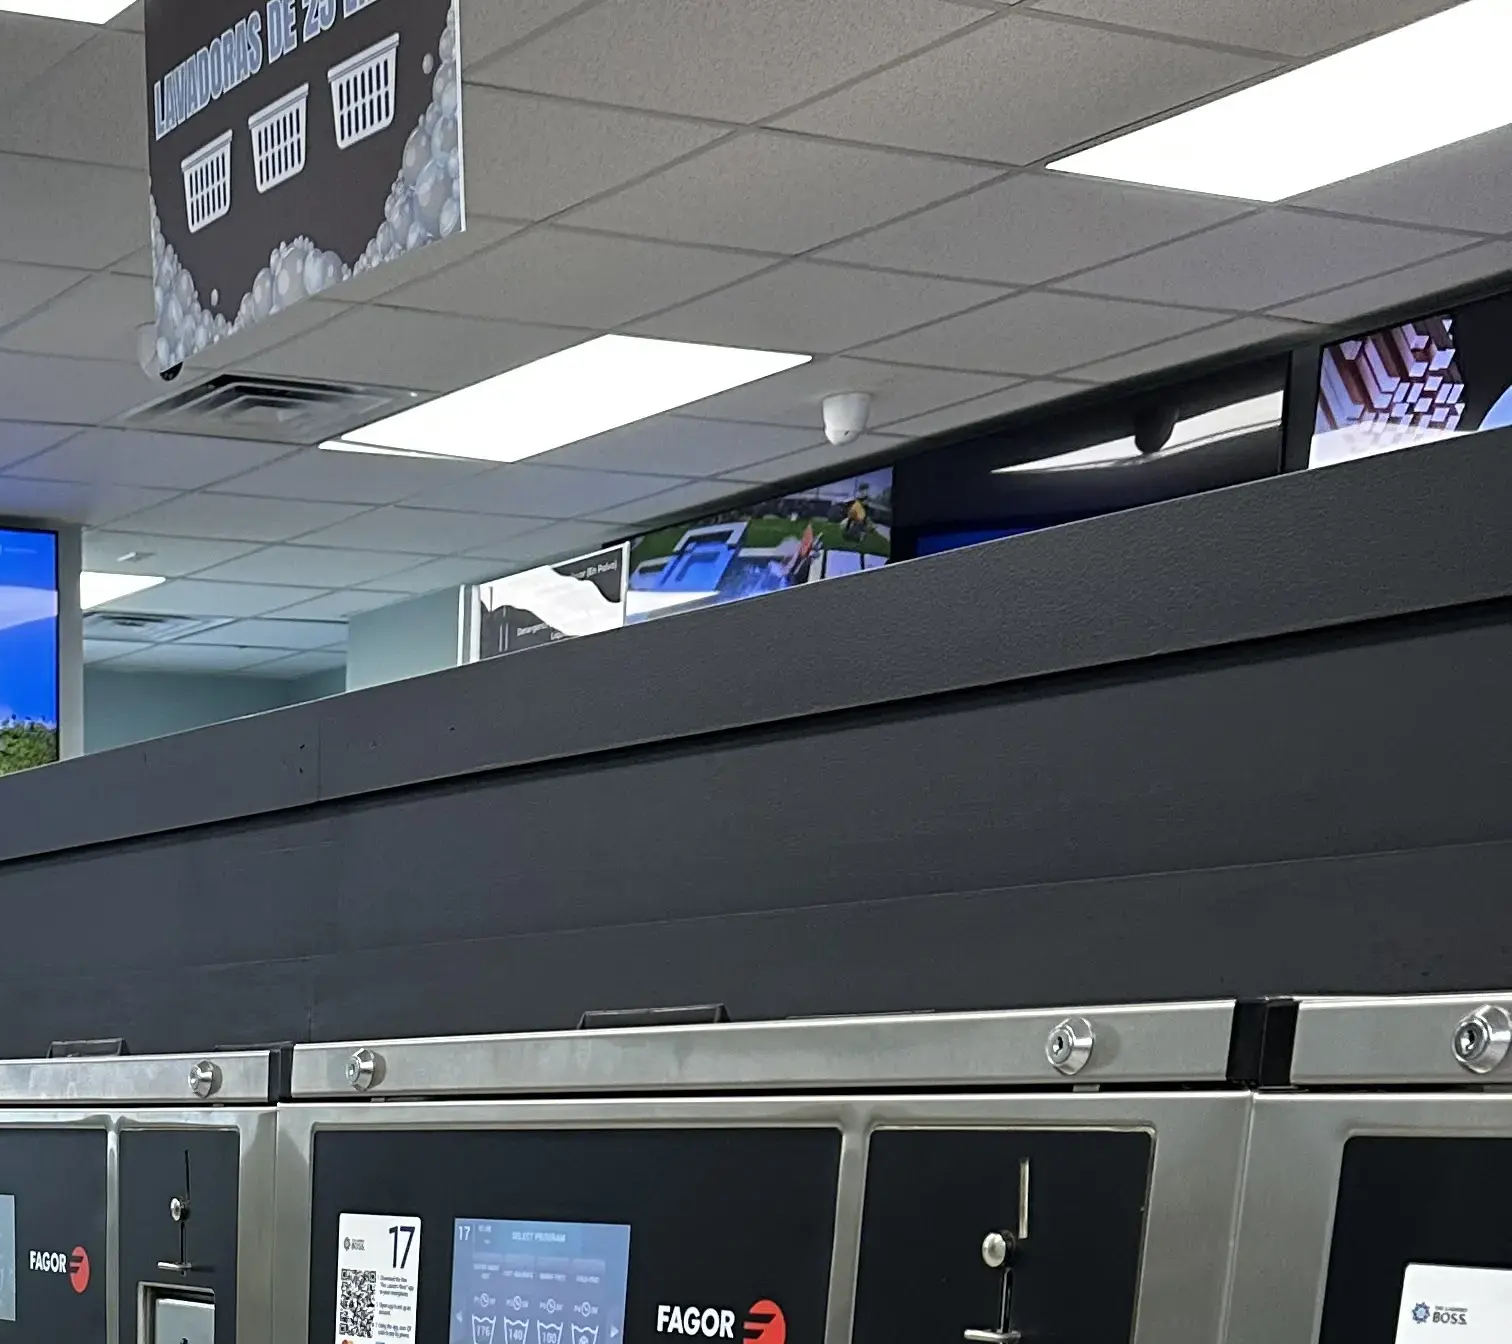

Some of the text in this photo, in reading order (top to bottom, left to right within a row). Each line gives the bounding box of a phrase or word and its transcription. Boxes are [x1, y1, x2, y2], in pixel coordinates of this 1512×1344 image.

[153, 0, 337, 141] LAVADORAS DE 25
[458, 1225, 471, 1241] 17
[389, 1225, 416, 1269] 17
[29, 1250, 67, 1274] FAGOR
[656, 1303, 737, 1340] FAGOR
[1432, 1311, 1468, 1325] BOSS
[508, 1328, 523, 1341] 140
